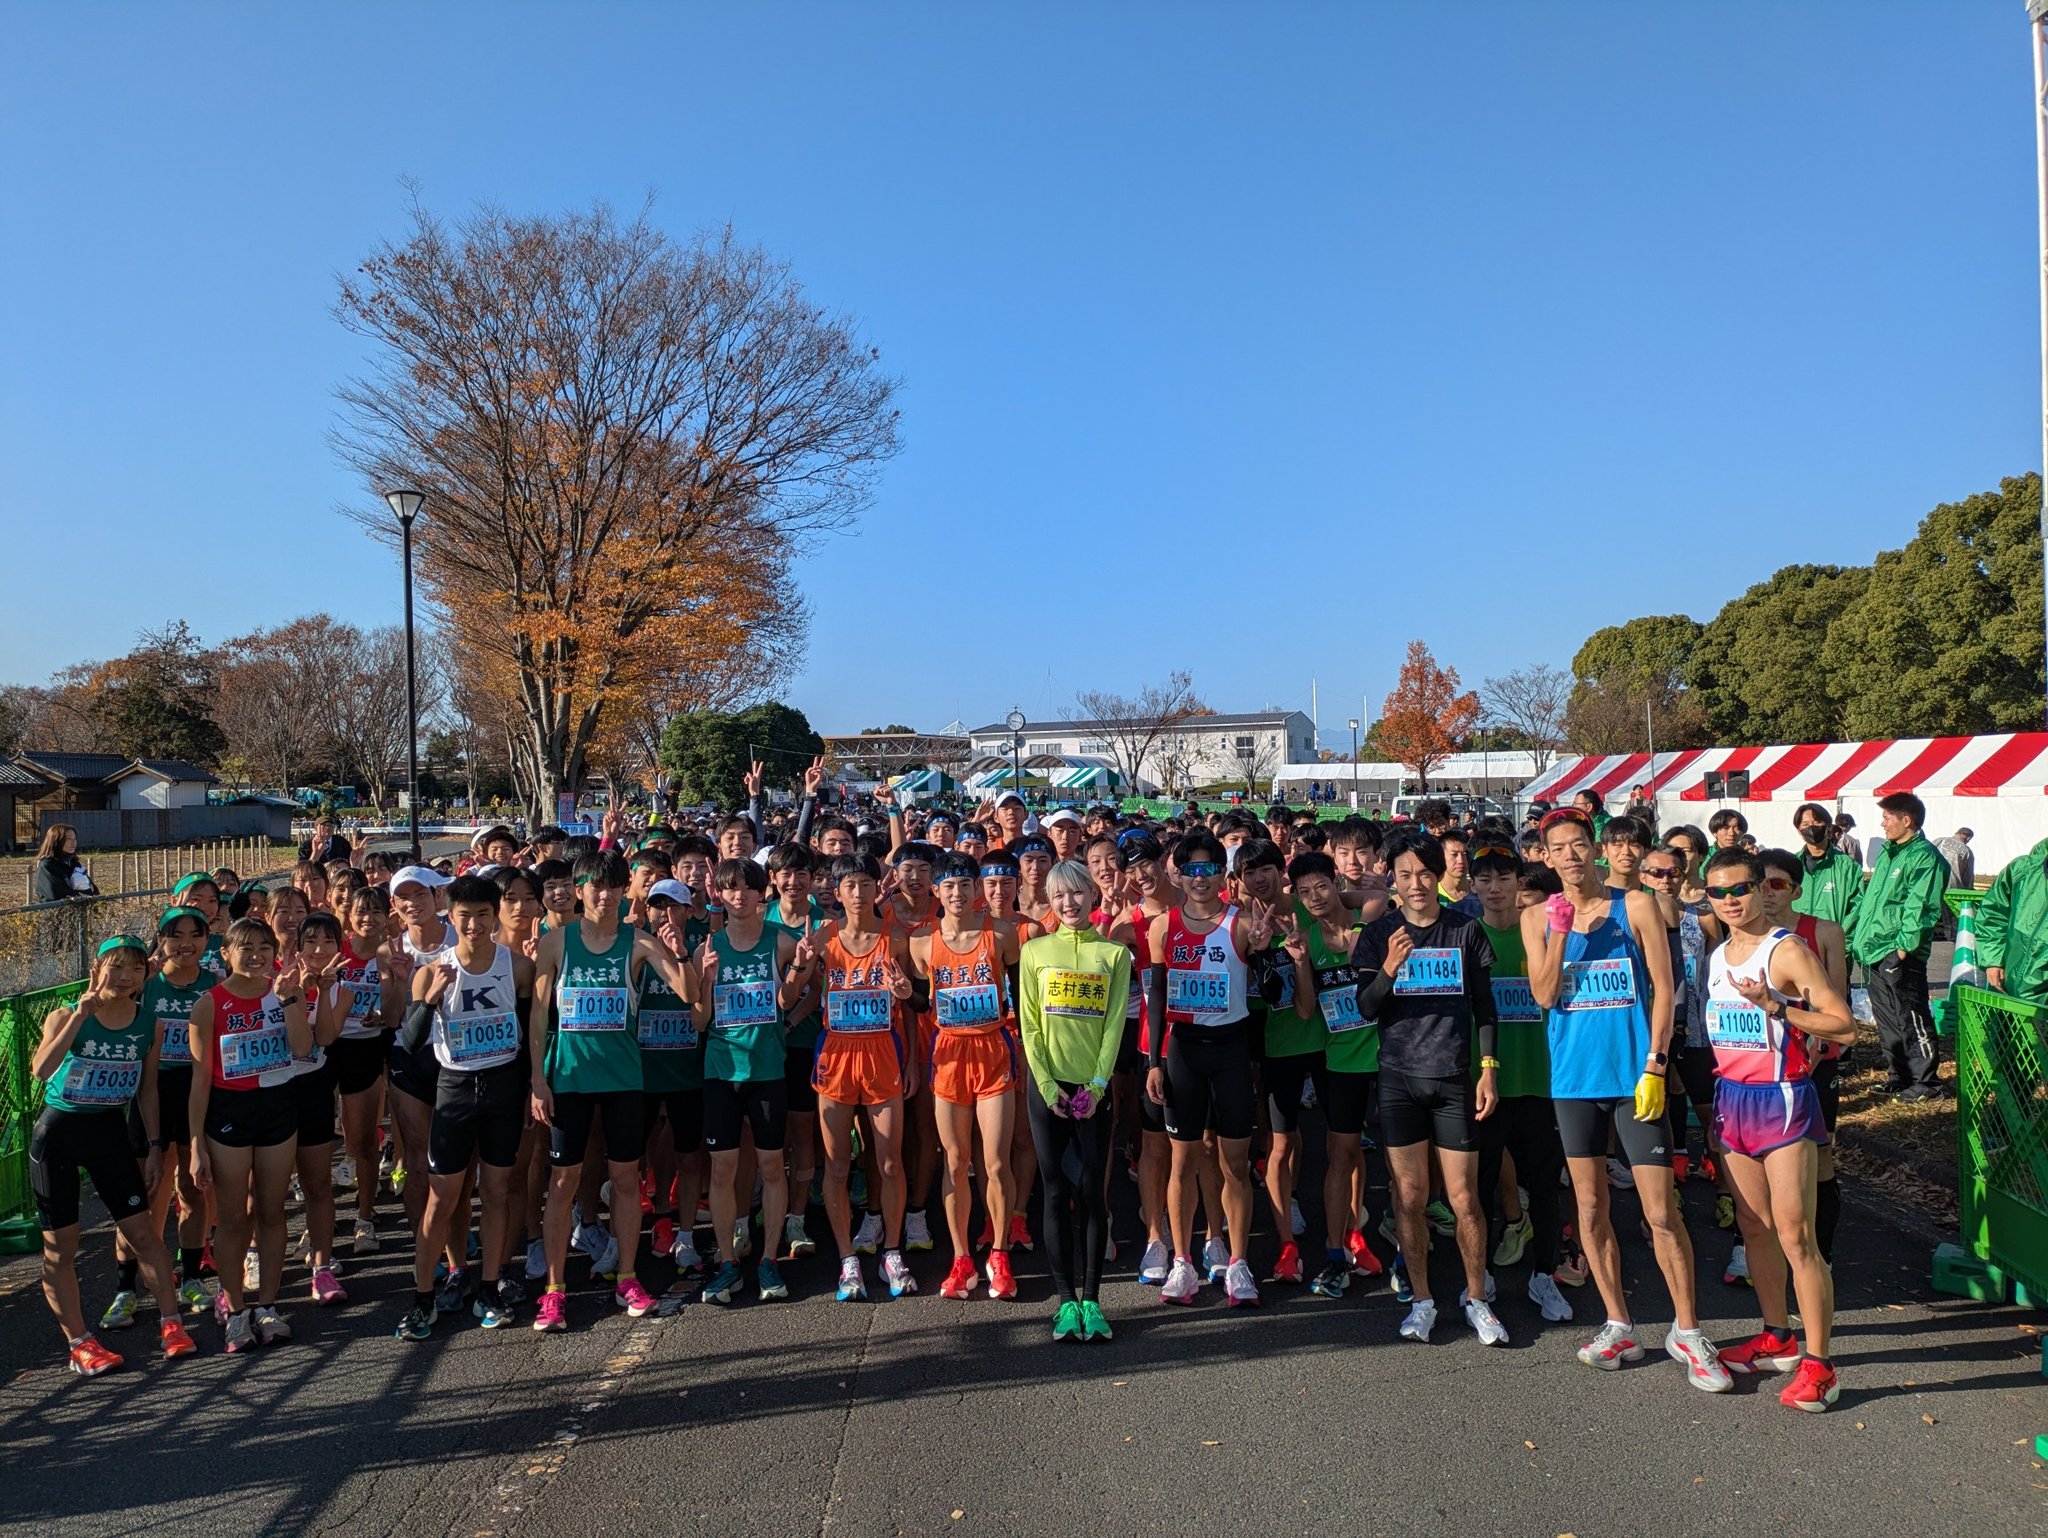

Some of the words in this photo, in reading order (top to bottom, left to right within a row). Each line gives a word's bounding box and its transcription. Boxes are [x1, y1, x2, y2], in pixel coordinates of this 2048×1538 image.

[1173, 945, 1226, 964] 坂戸西
[829, 967, 885, 987] 埼玉栄
[934, 963, 994, 985] 埼玉栄
[1048, 980, 1106, 1000] 志村美希
[1182, 979, 1226, 998] 10155
[461, 986, 499, 1012] K
[577, 997, 625, 1014] 10130
[729, 990, 773, 1009] 10129
[843, 998, 887, 1016] 10103
[951, 994, 994, 1013] 10111
[227, 1007, 285, 1031] 坂戸西
[465, 1022, 514, 1045] 10052
[240, 1034, 287, 1060] 15021
[87, 1069, 138, 1088] 15033
